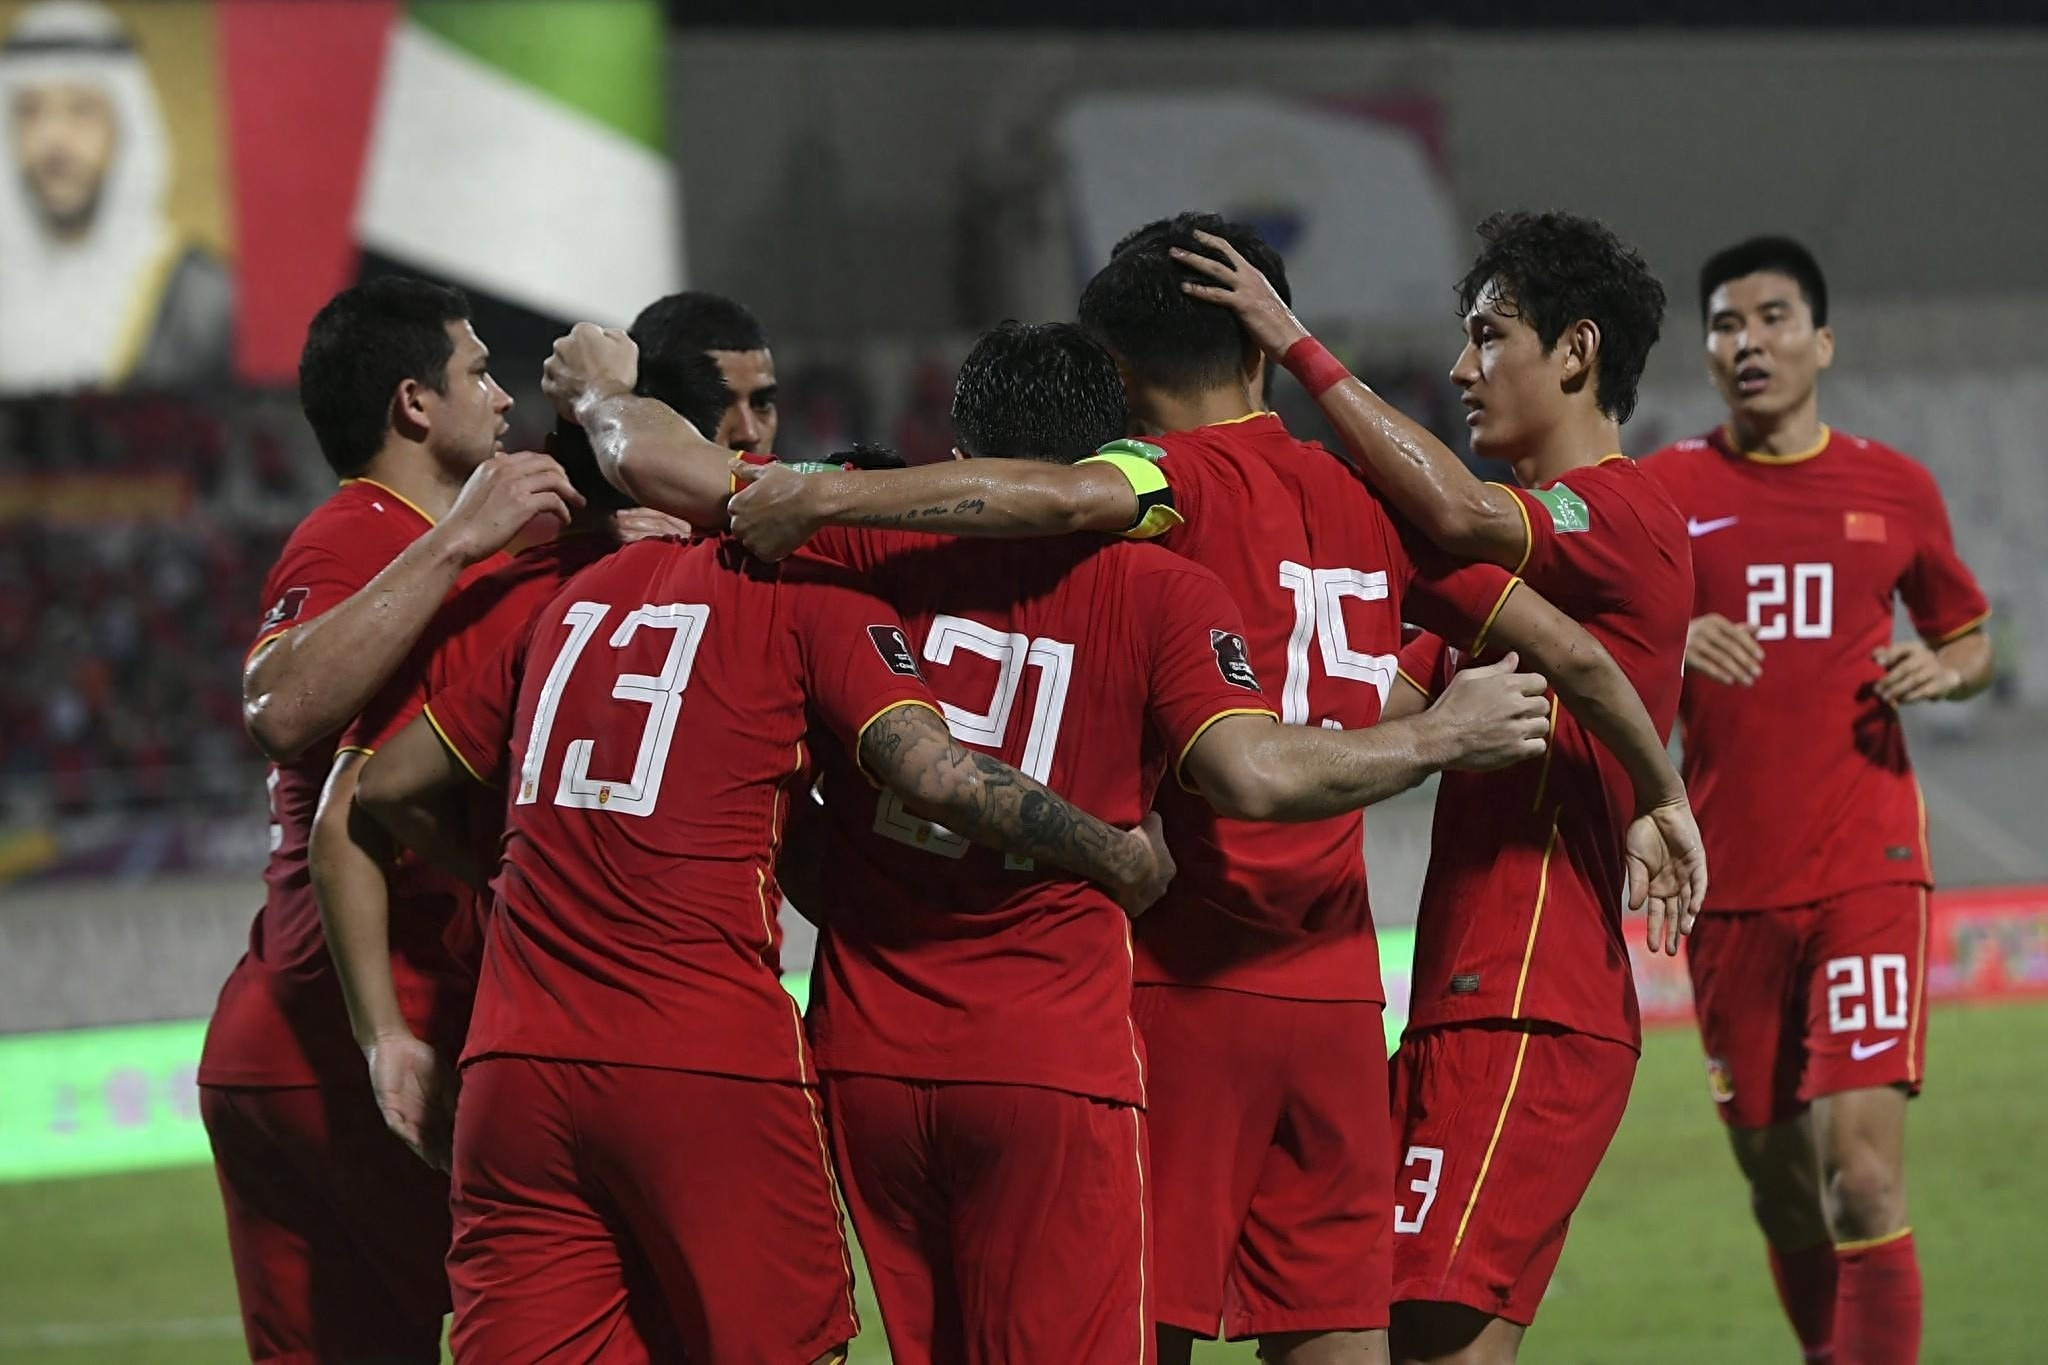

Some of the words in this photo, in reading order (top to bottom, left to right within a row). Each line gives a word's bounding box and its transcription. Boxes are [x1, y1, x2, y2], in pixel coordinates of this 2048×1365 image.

[1279, 559, 1398, 731] 15
[1746, 562, 1833, 640] 20
[516, 601, 710, 817] 13
[872, 614, 1075, 872] 21
[1827, 954, 1908, 1034] 20
[1394, 1146, 1444, 1234] 3
